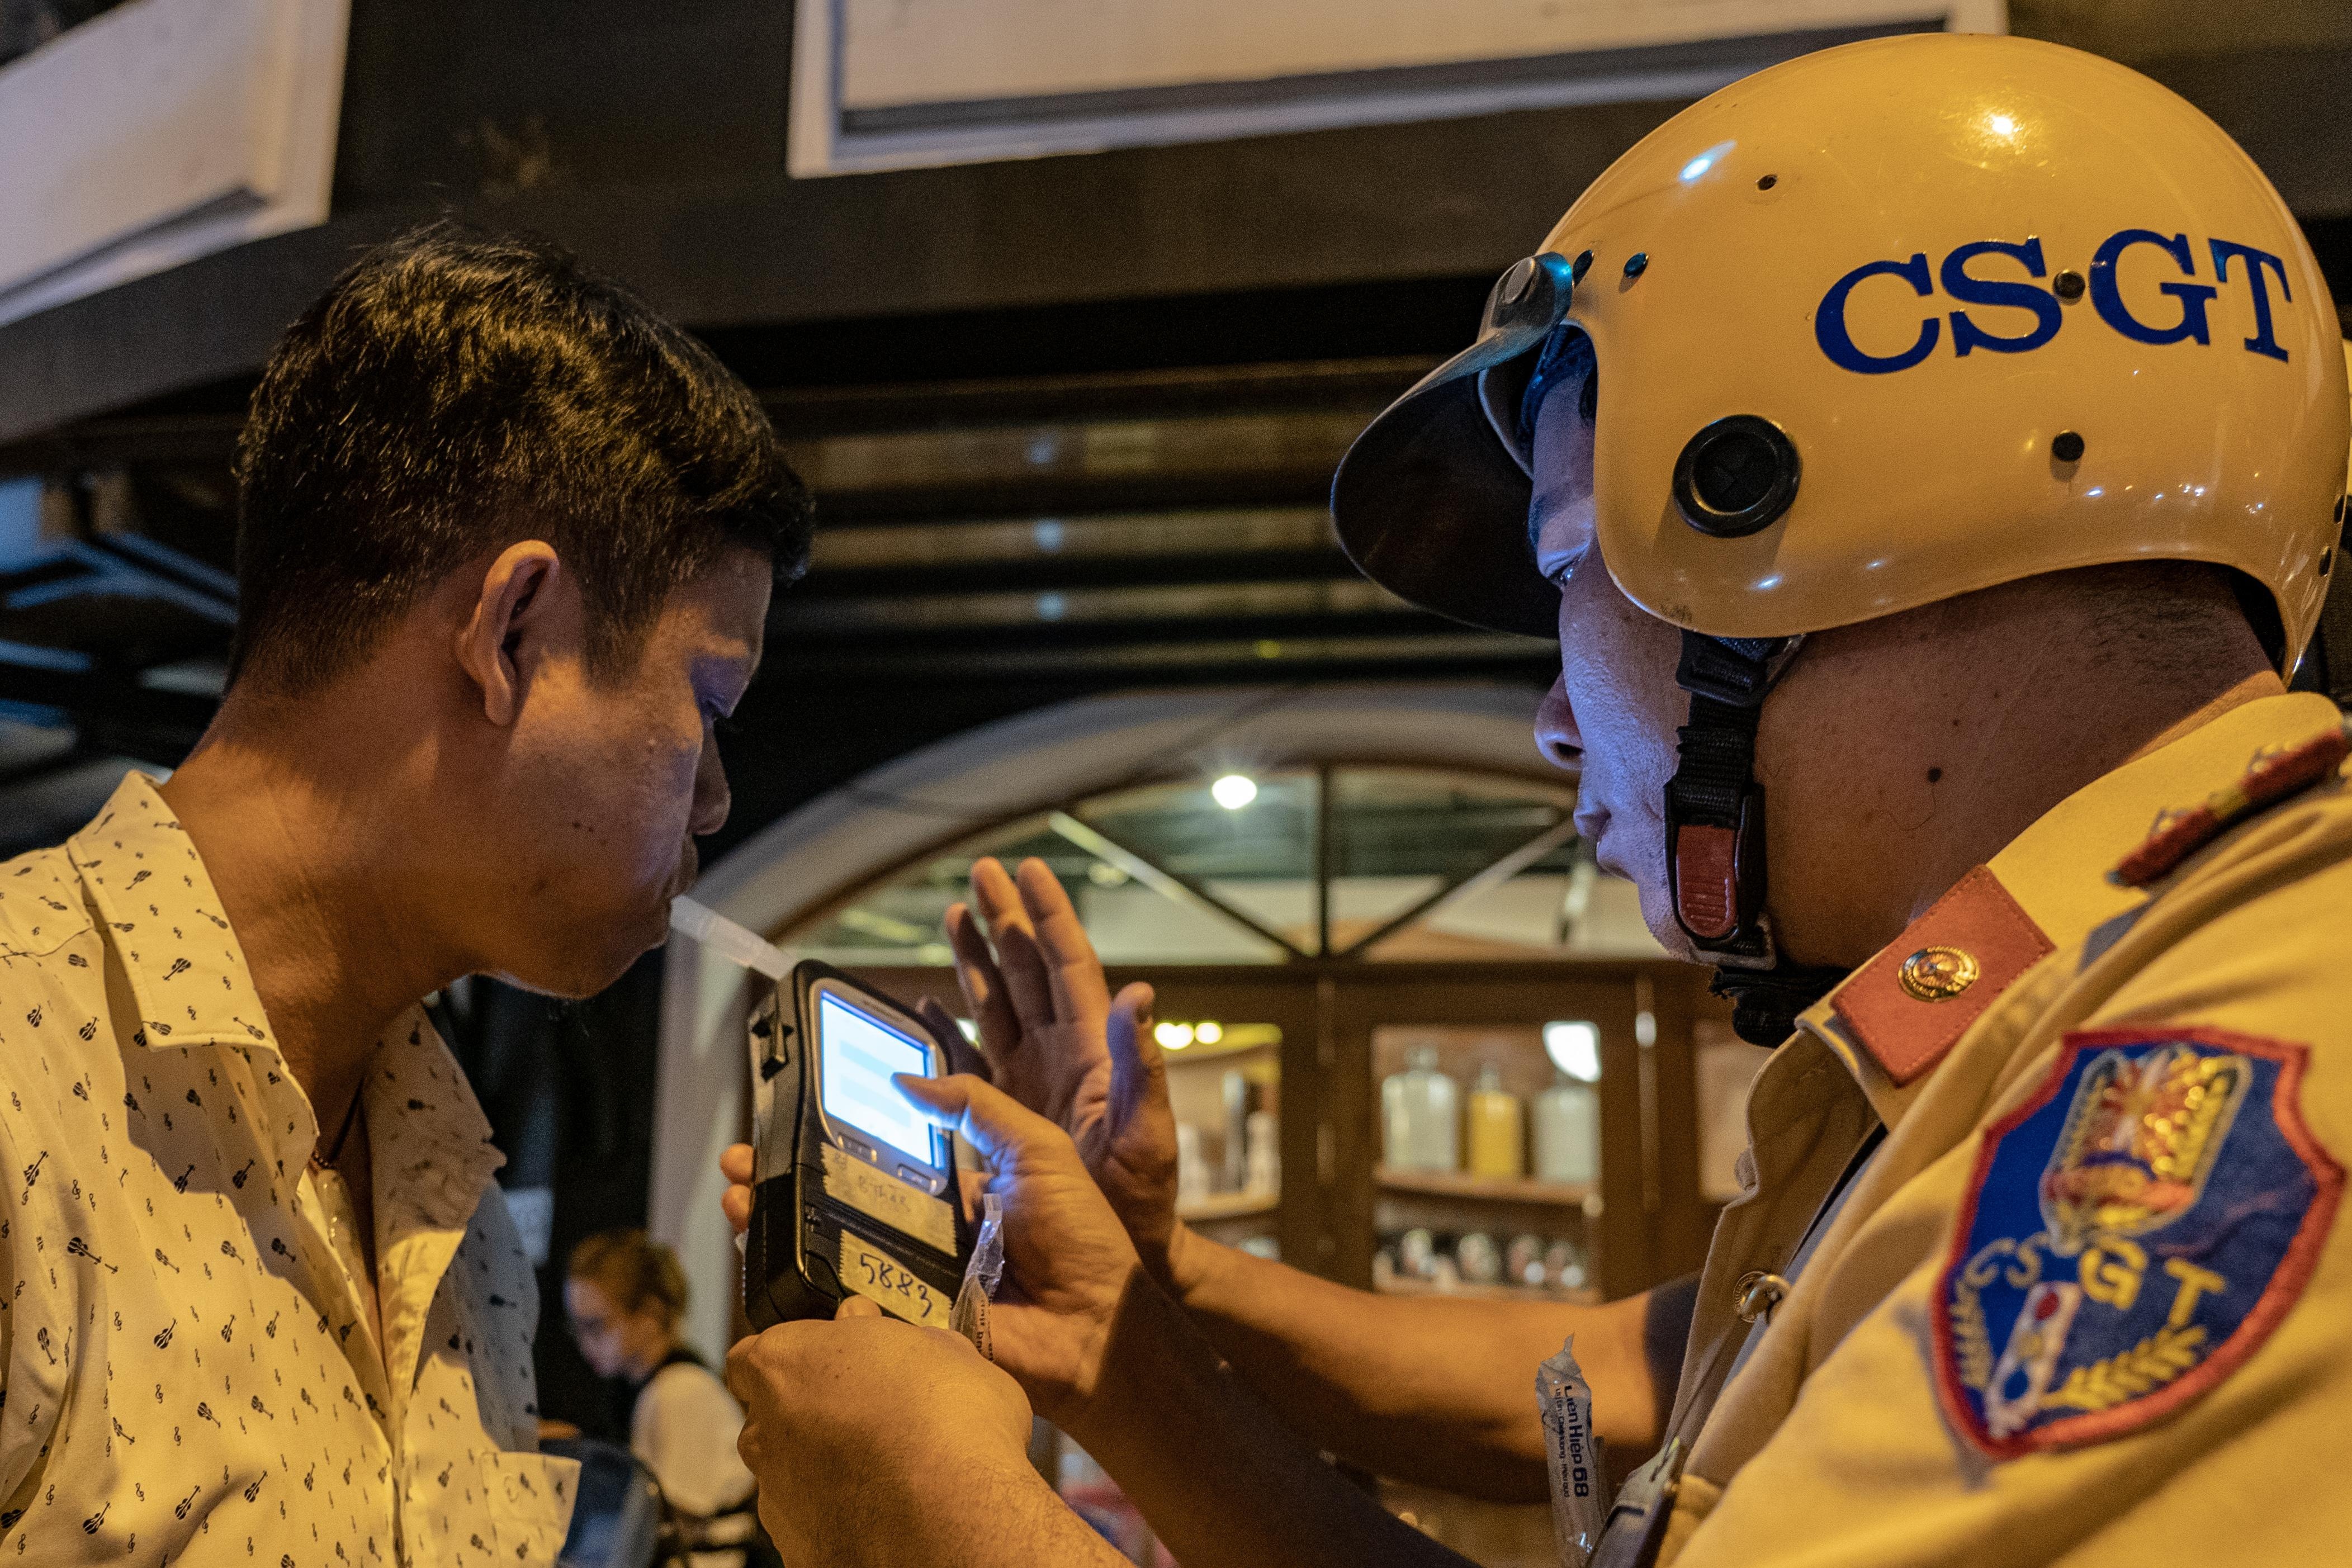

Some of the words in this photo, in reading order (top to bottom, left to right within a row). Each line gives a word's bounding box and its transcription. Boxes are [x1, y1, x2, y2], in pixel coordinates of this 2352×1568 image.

[1815, 228, 2292, 375] CSGT
[1963, 1231, 2225, 1327] CSGT
[1573, 1466, 1589, 1497] 68
